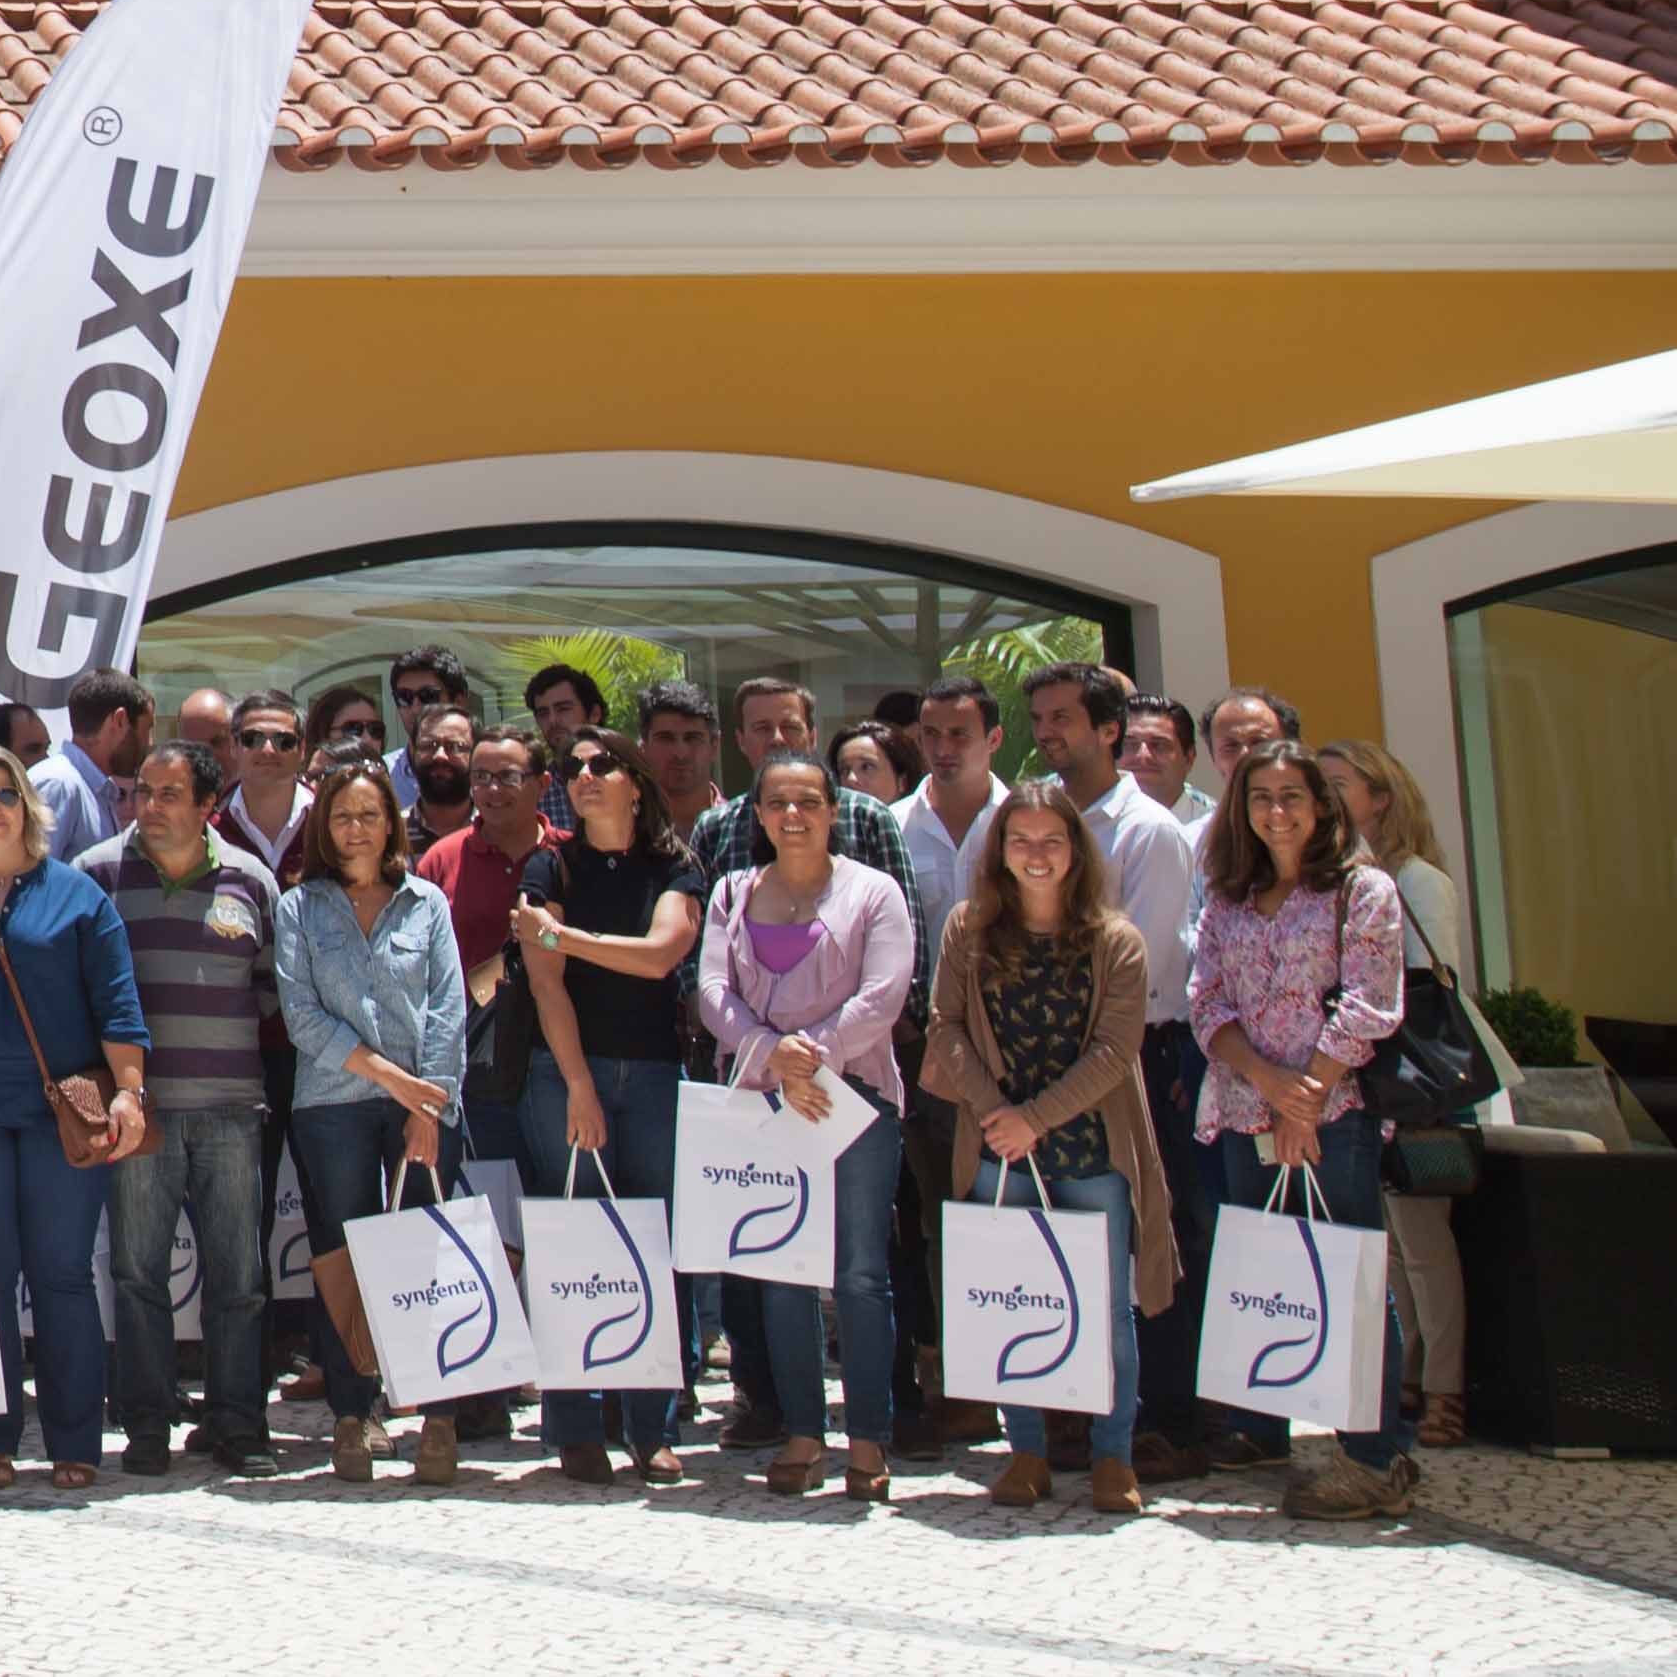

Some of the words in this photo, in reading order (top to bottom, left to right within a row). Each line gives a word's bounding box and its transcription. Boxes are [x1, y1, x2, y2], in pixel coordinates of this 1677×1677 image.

[701, 1162, 795, 1190] syngenta
[391, 1278, 479, 1311] syngenta
[550, 1273, 639, 1300] syngenta
[966, 1284, 1065, 1314] syngenta
[1229, 1286, 1317, 1321] syngenta
